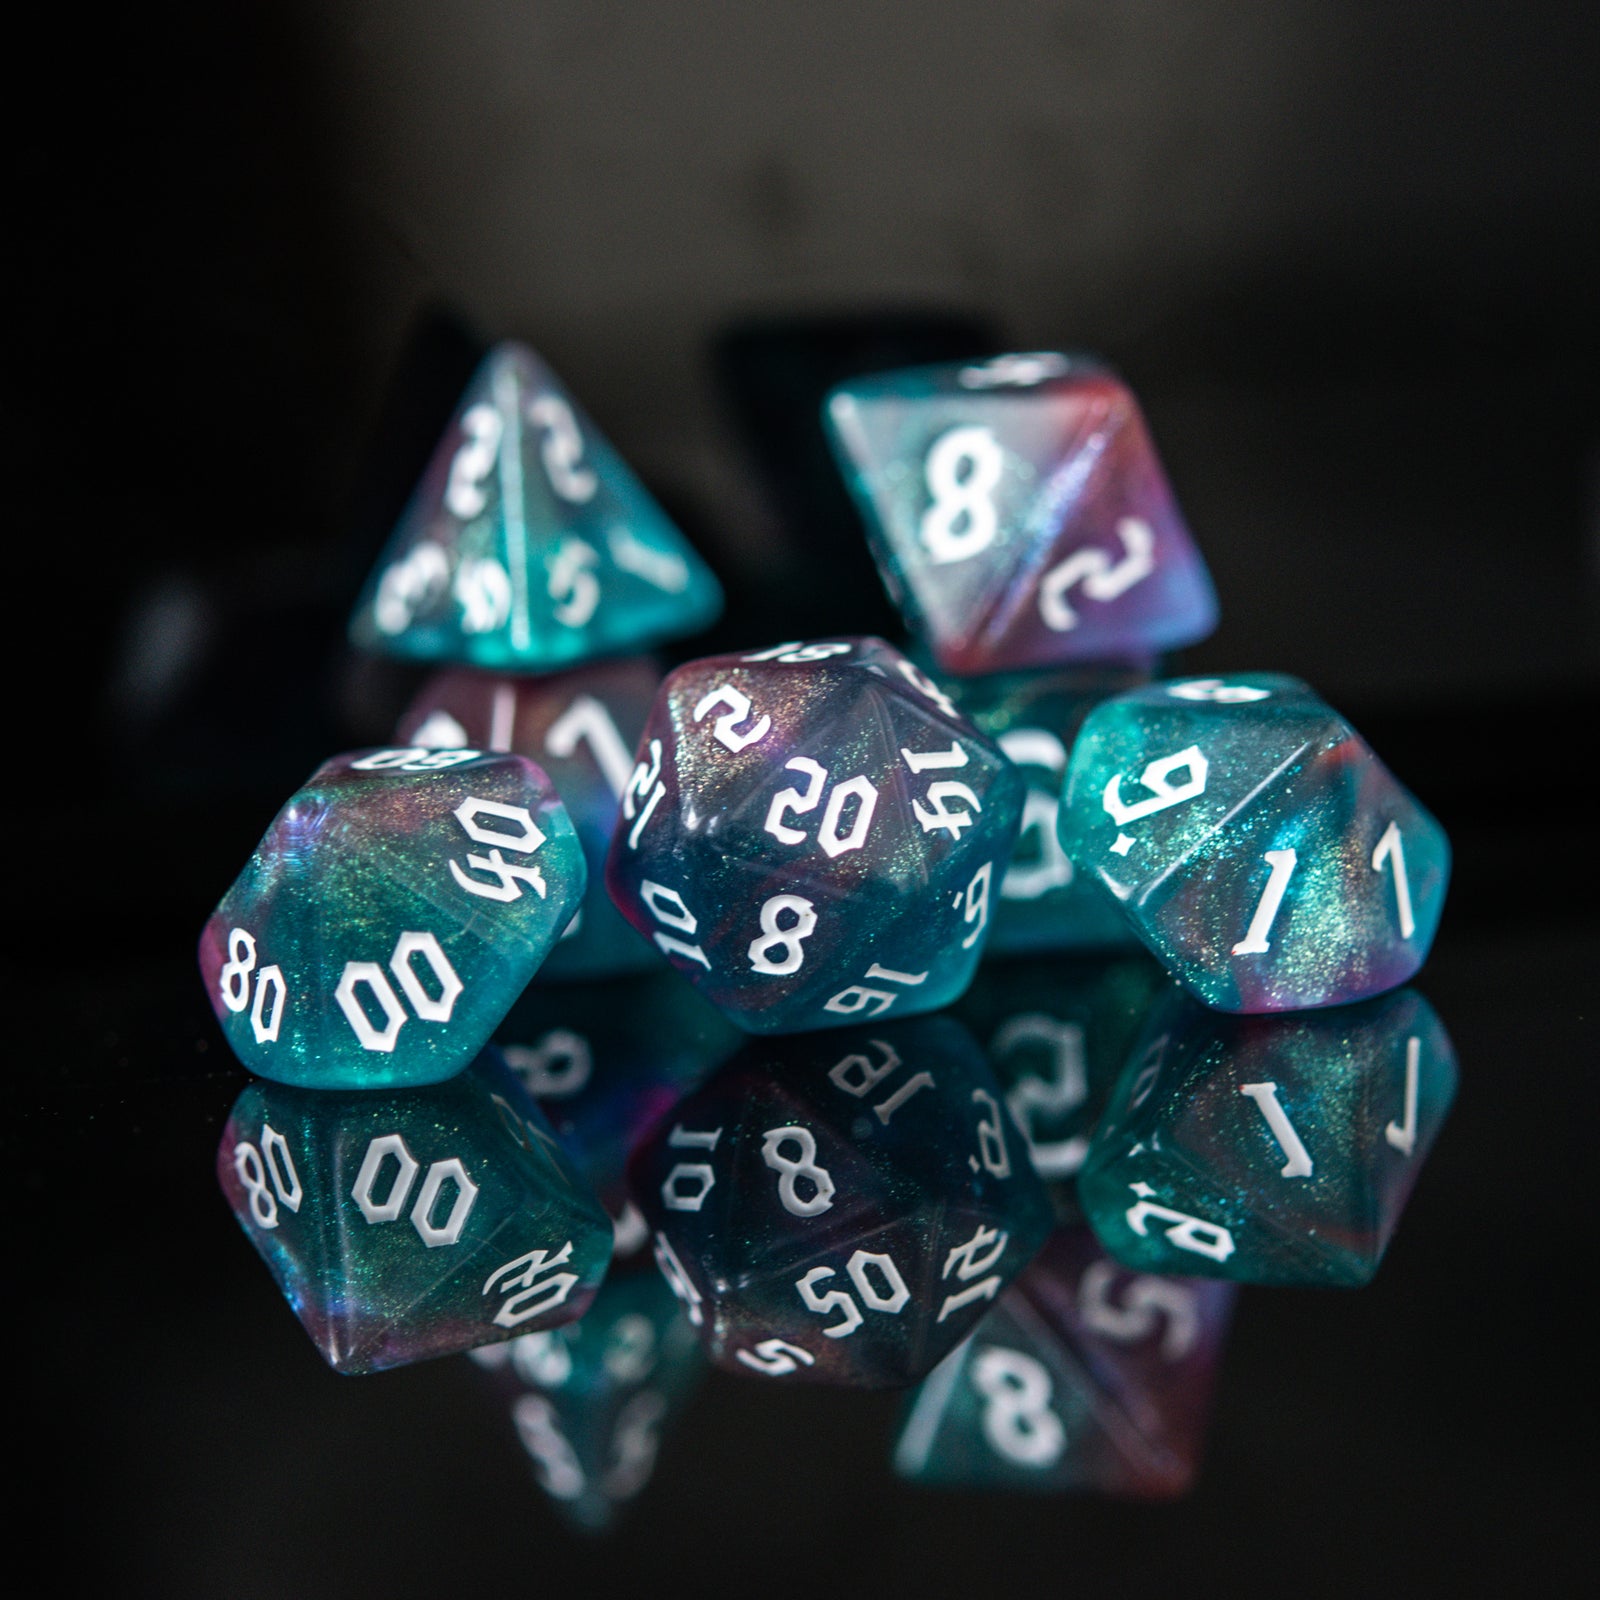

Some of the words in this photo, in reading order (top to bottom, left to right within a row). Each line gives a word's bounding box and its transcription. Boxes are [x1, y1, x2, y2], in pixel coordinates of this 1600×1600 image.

[923, 428, 1007, 563] 8
[1038, 516, 1155, 632] 2
[693, 684, 771, 754] 2
[765, 757, 878, 857] 20
[901, 742, 981, 840] 14
[450, 797, 546, 902] 40
[1233, 849, 1296, 955] 1
[643, 884, 710, 968] 10
[749, 895, 817, 974] 8
[221, 928, 286, 1043] 80
[336, 933, 463, 1052] 00
